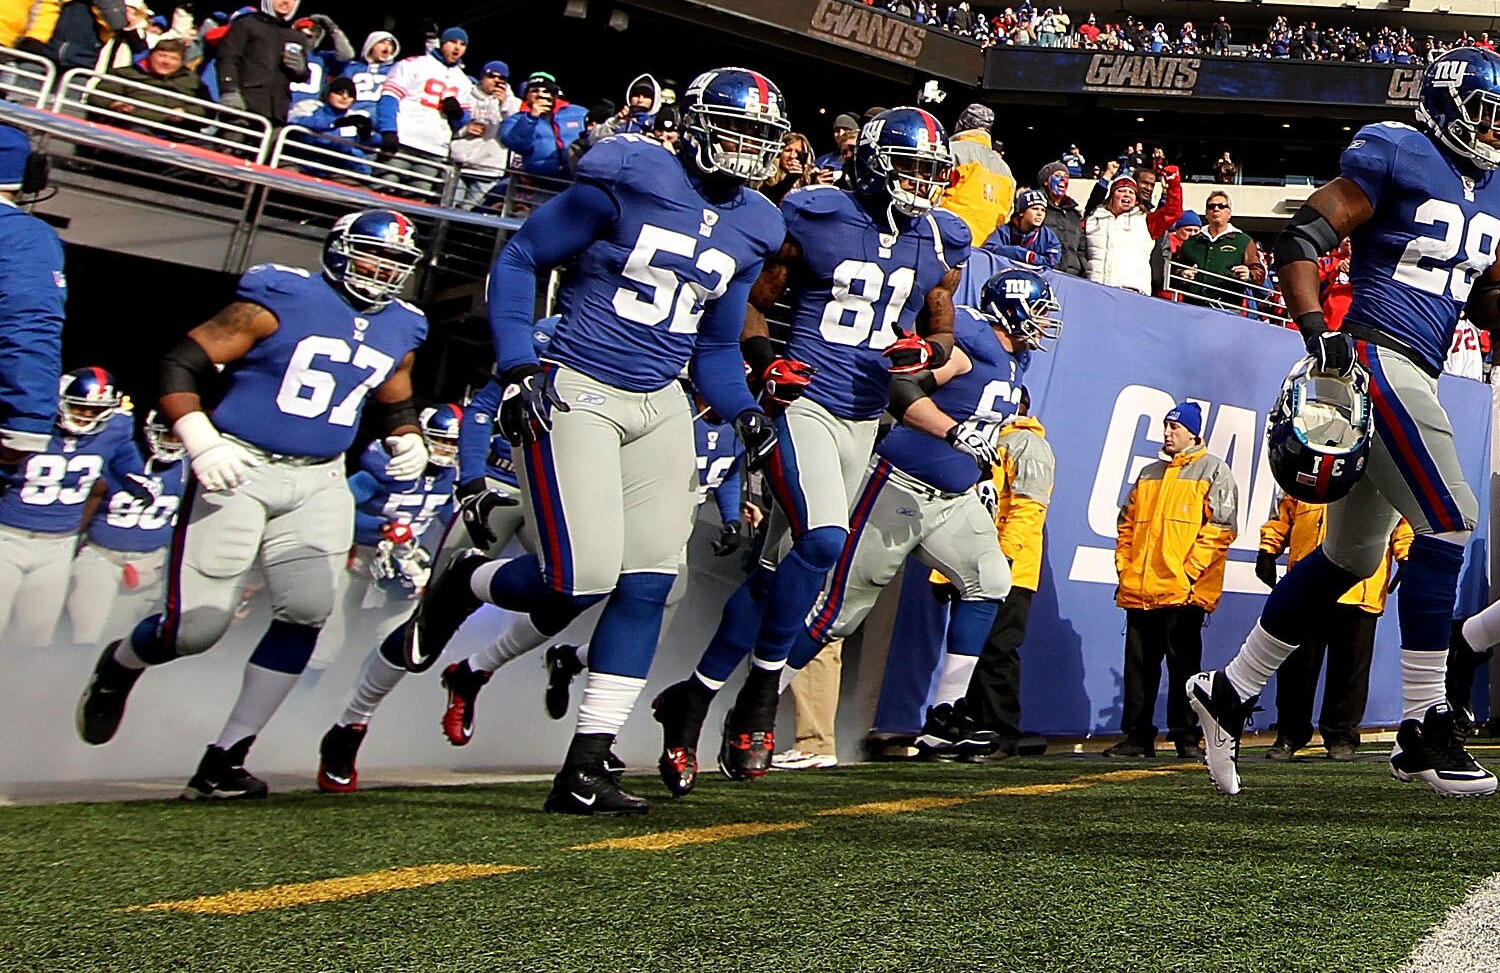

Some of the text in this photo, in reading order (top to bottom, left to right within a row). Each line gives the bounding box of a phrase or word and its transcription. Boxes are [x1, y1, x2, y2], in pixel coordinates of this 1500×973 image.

[1085, 54, 1201, 90] GIANTS
[1434, 60, 1469, 88] ny
[611, 224, 737, 334] 52
[1005, 279, 1032, 299] ny
[818, 260, 916, 349] 81
[1451, 327, 1477, 354] 72
[276, 333, 396, 427] 67
[20, 454, 104, 506] 83
